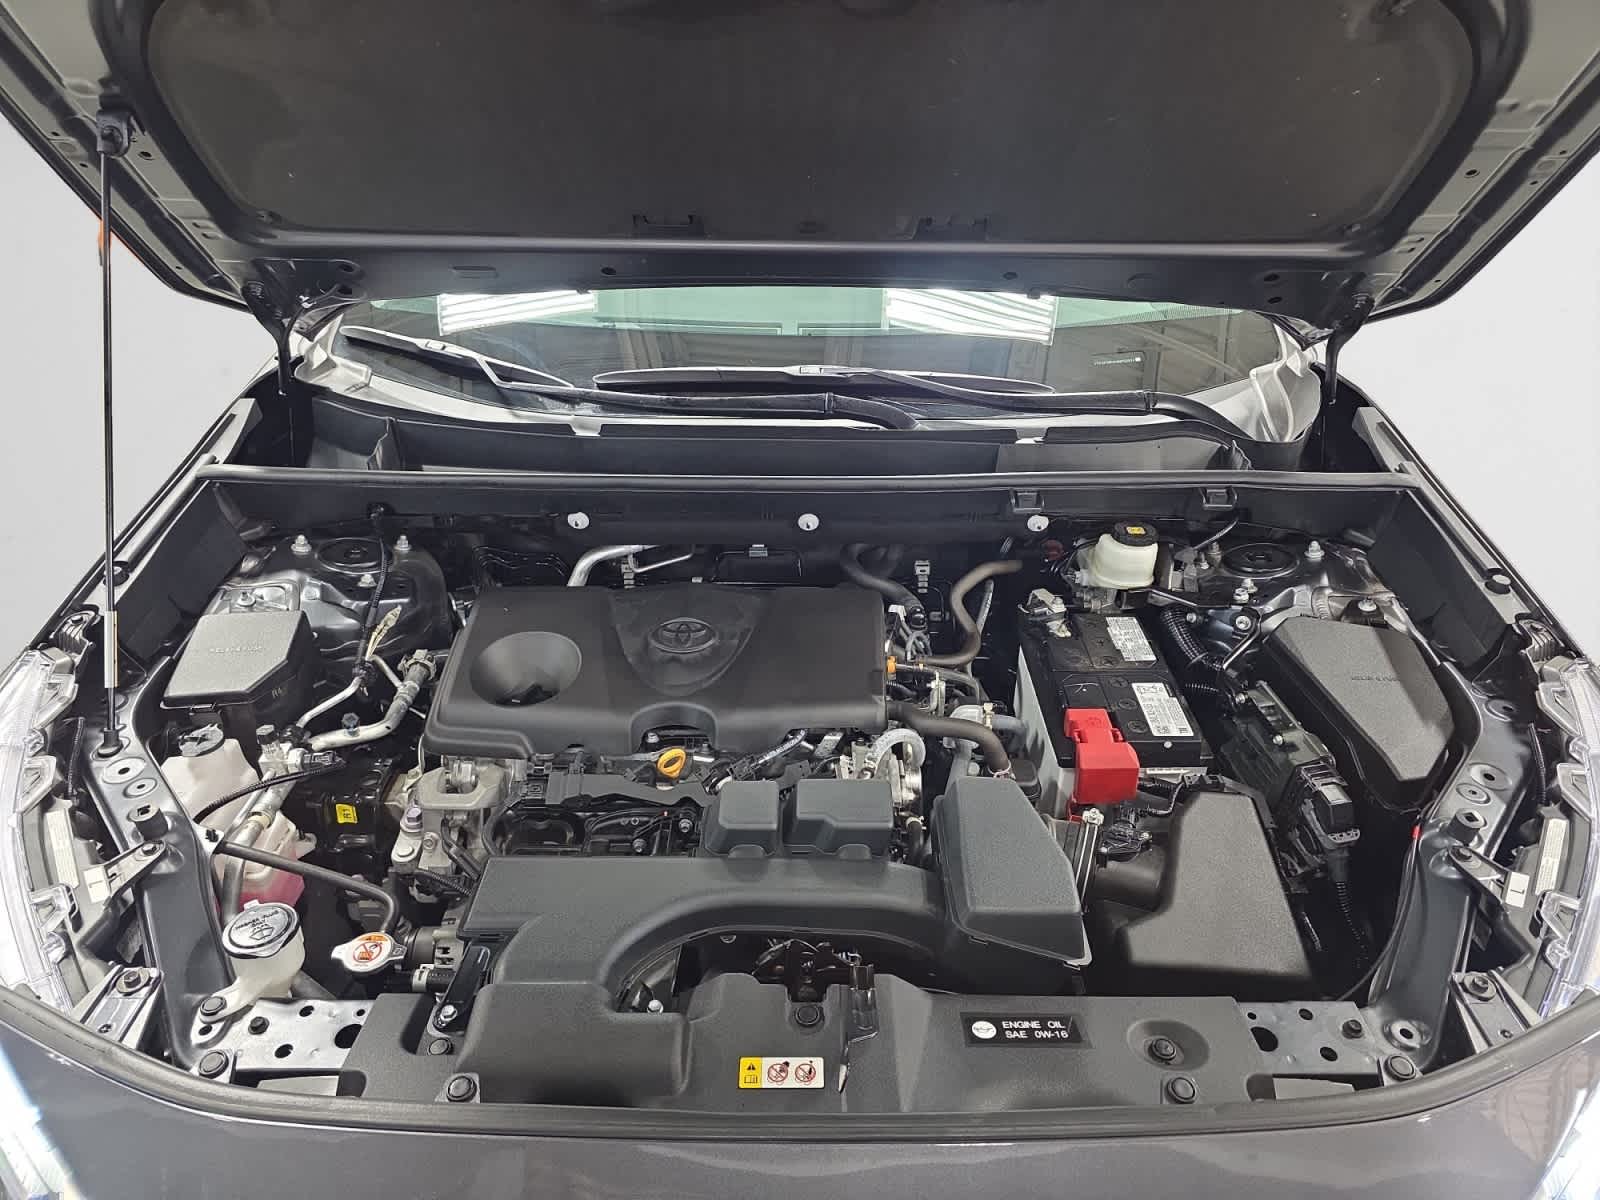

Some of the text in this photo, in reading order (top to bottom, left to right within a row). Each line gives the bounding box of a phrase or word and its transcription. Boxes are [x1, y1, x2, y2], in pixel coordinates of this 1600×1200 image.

[1002, 1020, 1066, 1029] ENGINE OIL
[1005, 1030, 1069, 1039] SAE 0W-16
